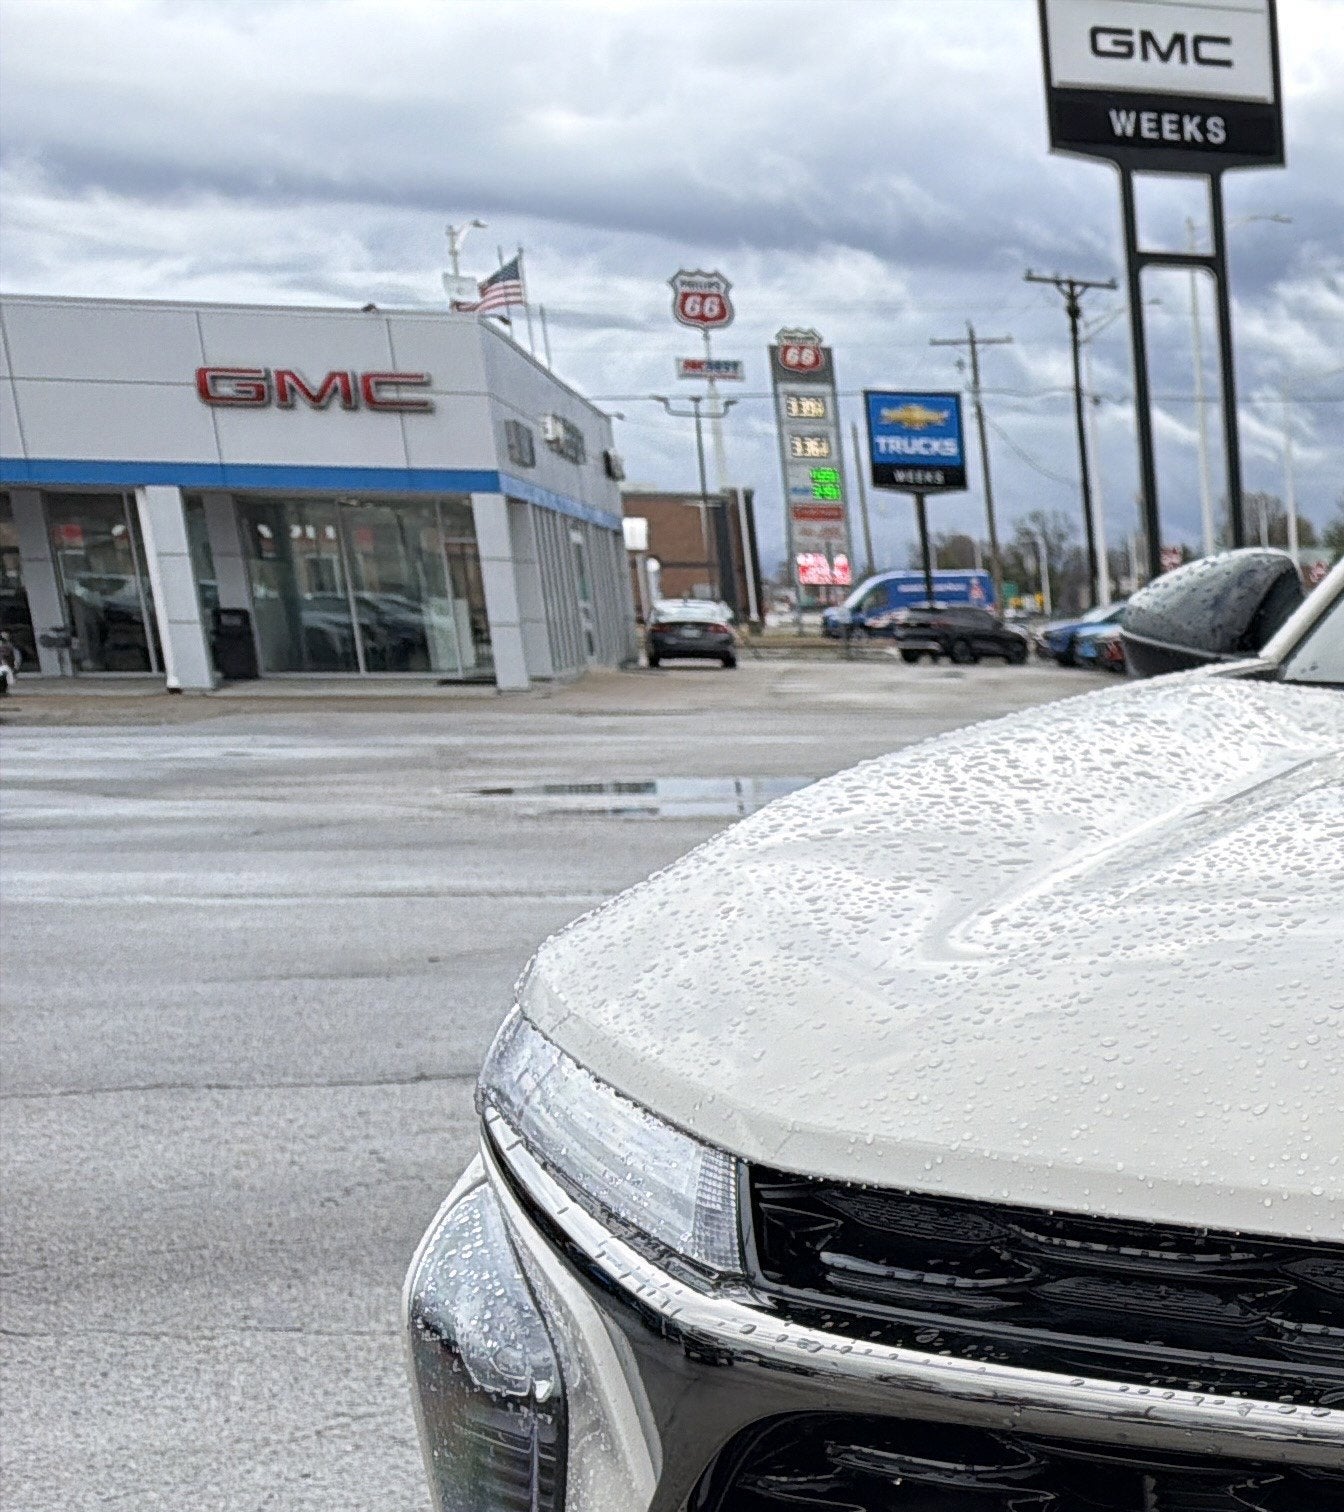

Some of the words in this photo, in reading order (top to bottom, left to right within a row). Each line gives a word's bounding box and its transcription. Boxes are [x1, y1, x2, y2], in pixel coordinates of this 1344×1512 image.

[1090, 26, 1233, 68] GMC
[1108, 108, 1227, 145] WEEKS
[684, 294, 721, 318] 66
[785, 347, 816, 367] 66
[195, 366, 433, 411] GMC
[873, 435, 959, 457] TRUCKS
[892, 468, 946, 485] WEEKS
